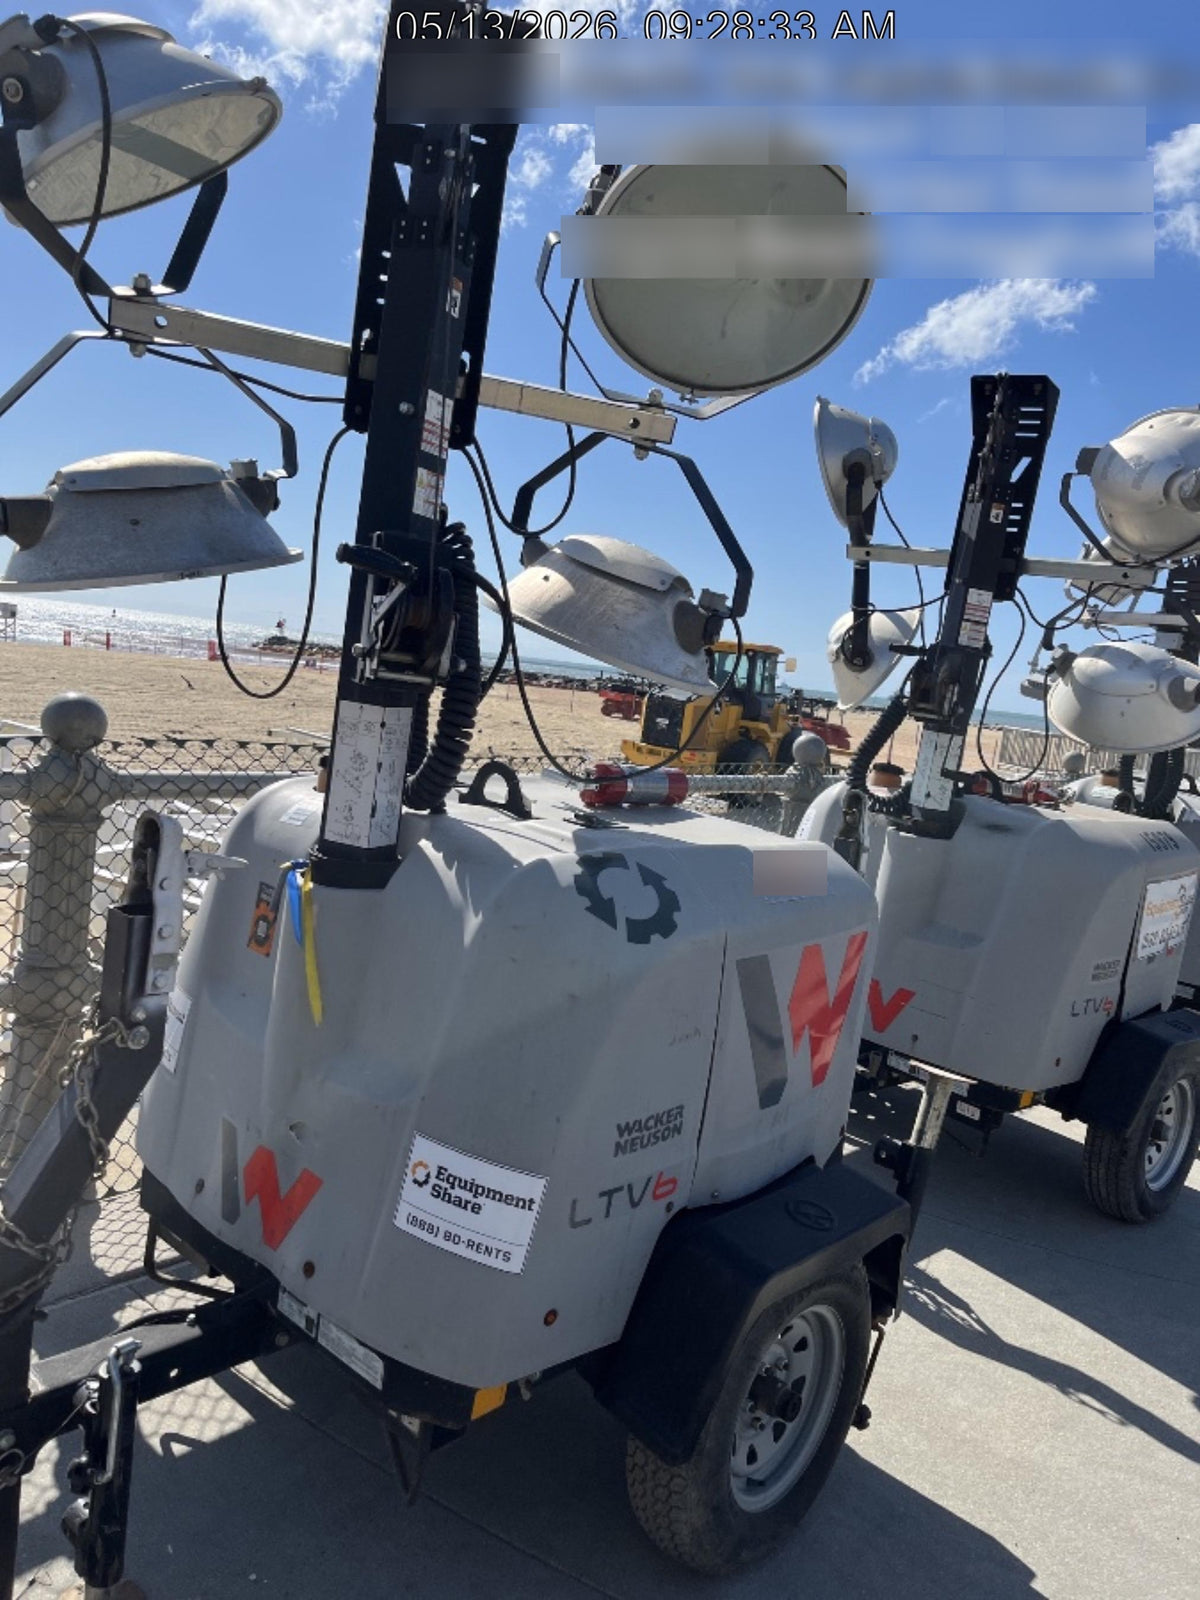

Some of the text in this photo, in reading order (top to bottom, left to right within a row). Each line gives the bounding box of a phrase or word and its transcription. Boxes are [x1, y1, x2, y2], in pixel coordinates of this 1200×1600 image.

[613, 1120, 683, 1158] NEUSON
[616, 1104, 685, 1138] WACKER
[430, 1183, 483, 1215] Share
[434, 1164, 536, 1212] Equipment
[569, 1171, 678, 1229] LTV6
[406, 1212, 440, 1238] (888)
